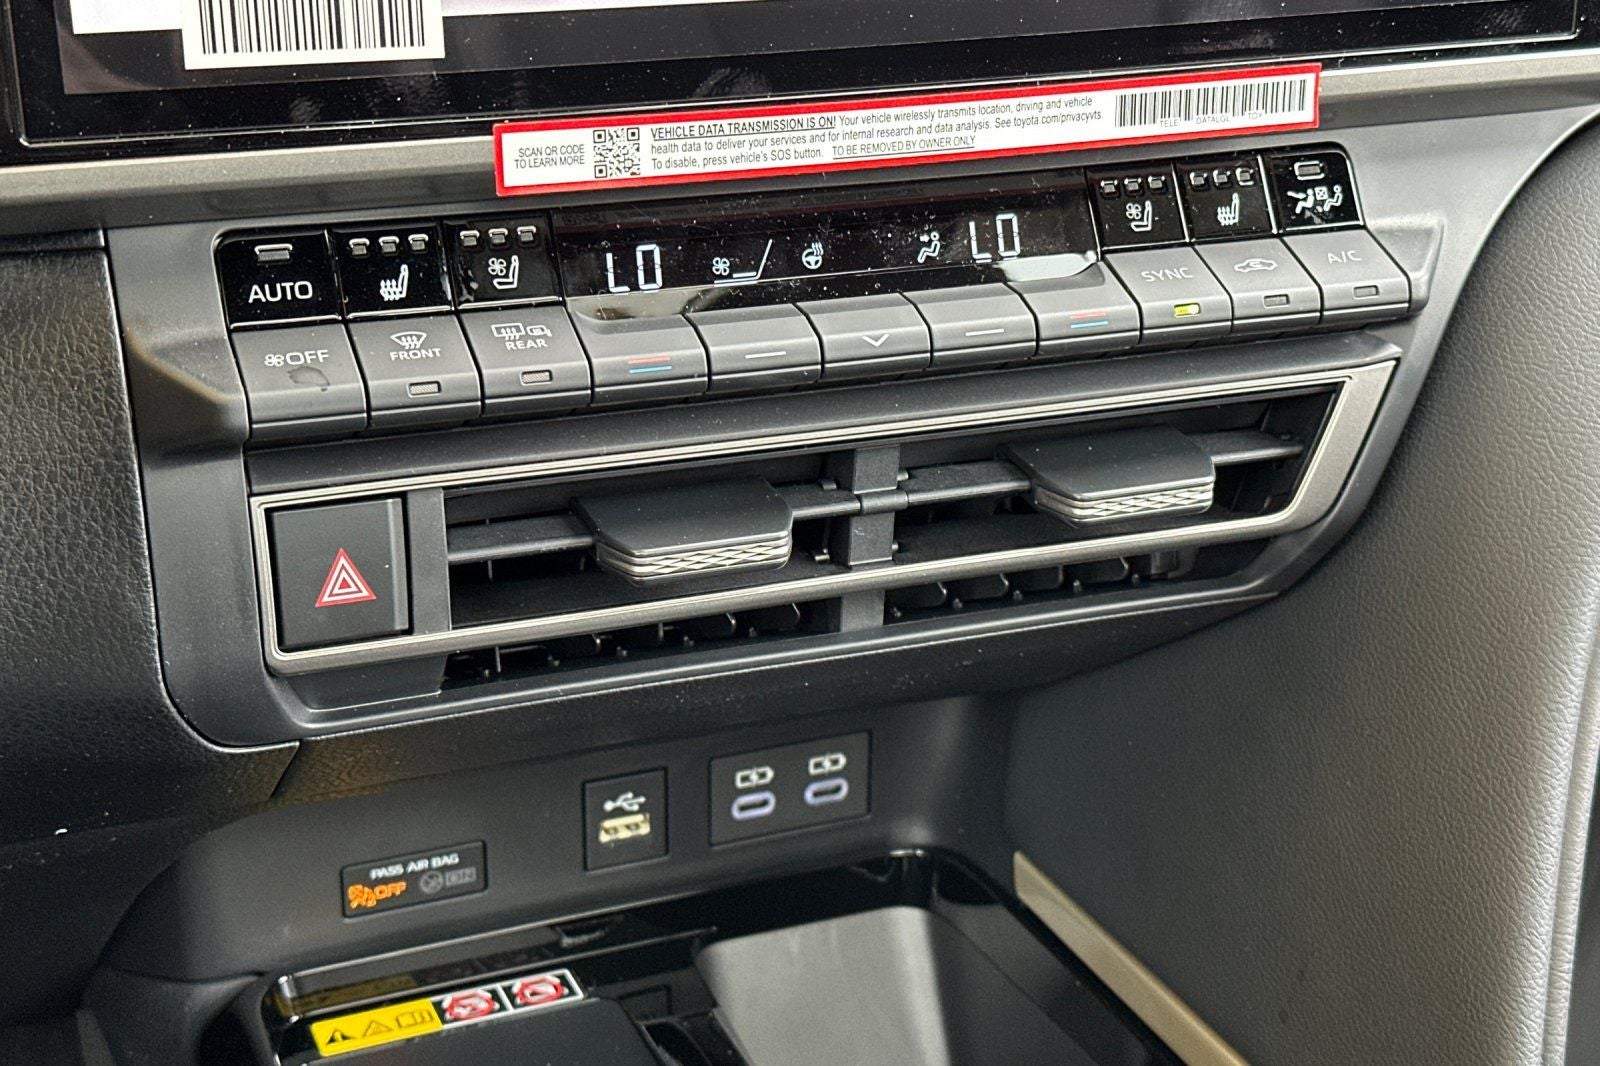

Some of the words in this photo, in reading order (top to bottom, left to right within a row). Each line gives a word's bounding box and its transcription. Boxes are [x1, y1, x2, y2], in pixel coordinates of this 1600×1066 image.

[651, 125, 695, 139] VEHICLE
[699, 124, 724, 136] DATA
[728, 118, 804, 134] TRANSMISSION
[806, 118, 816, 128] IS
[819, 116, 836, 127] ON!
[839, 115, 858, 126] Your
[861, 111, 891, 124] vehicle
[894, 109, 935, 123] wirelessly
[938, 106, 976, 118] transmits
[978, 103, 1013, 116] location,
[1016, 101, 1043, 113] driving
[1046, 98, 1061, 110] and
[1064, 96, 1093, 108] vehicle
[651, 141, 679, 155] health
[681, 140, 702, 153] data
[704, 139, 713, 151] to
[716, 137, 746, 150] deliver
[750, 137, 768, 150] your
[770, 133, 807, 148] services
[809, 131, 825, 144] and
[828, 131, 839, 142] for
[842, 127, 874, 140] internal
[876, 125, 914, 138] research
[916, 122, 933, 135] and
[935, 120, 953, 133] data
[994, 117, 1012, 129] See
[518, 147, 543, 158] SCAN
[560, 144, 585, 155] CODE
[652, 158, 662, 170] To
[665, 155, 700, 169] disable,
[703, 154, 727, 168] press
[730, 151, 768, 165] vehicle's
[770, 148, 791, 161] SOS
[794, 147, 824, 159] button.
[832, 145, 844, 156] TO
[846, 144, 858, 155] BE
[860, 140, 904, 154] REMOVED
[906, 140, 917, 150] BY
[919, 137, 951, 149] OWNER
[953, 135, 976, 146] ONLY
[514, 159, 527, 169] TO
[529, 157, 557, 168] LEARN
[559, 155, 585, 166] MORE
[968, 212, 1022, 263] LO
[1327, 250, 1363, 265] A/C
[605, 243, 663, 294] LO
[1140, 266, 1194, 283] SYNC
[248, 280, 314, 304] AUTO
[505, 338, 548, 351] REAR
[286, 349, 329, 366] OFF
[390, 347, 442, 362] FRONT
[369, 863, 404, 880] PASS
[406, 859, 429, 874] AIR
[430, 852, 460, 869] BAG
[374, 881, 407, 900] OFF
